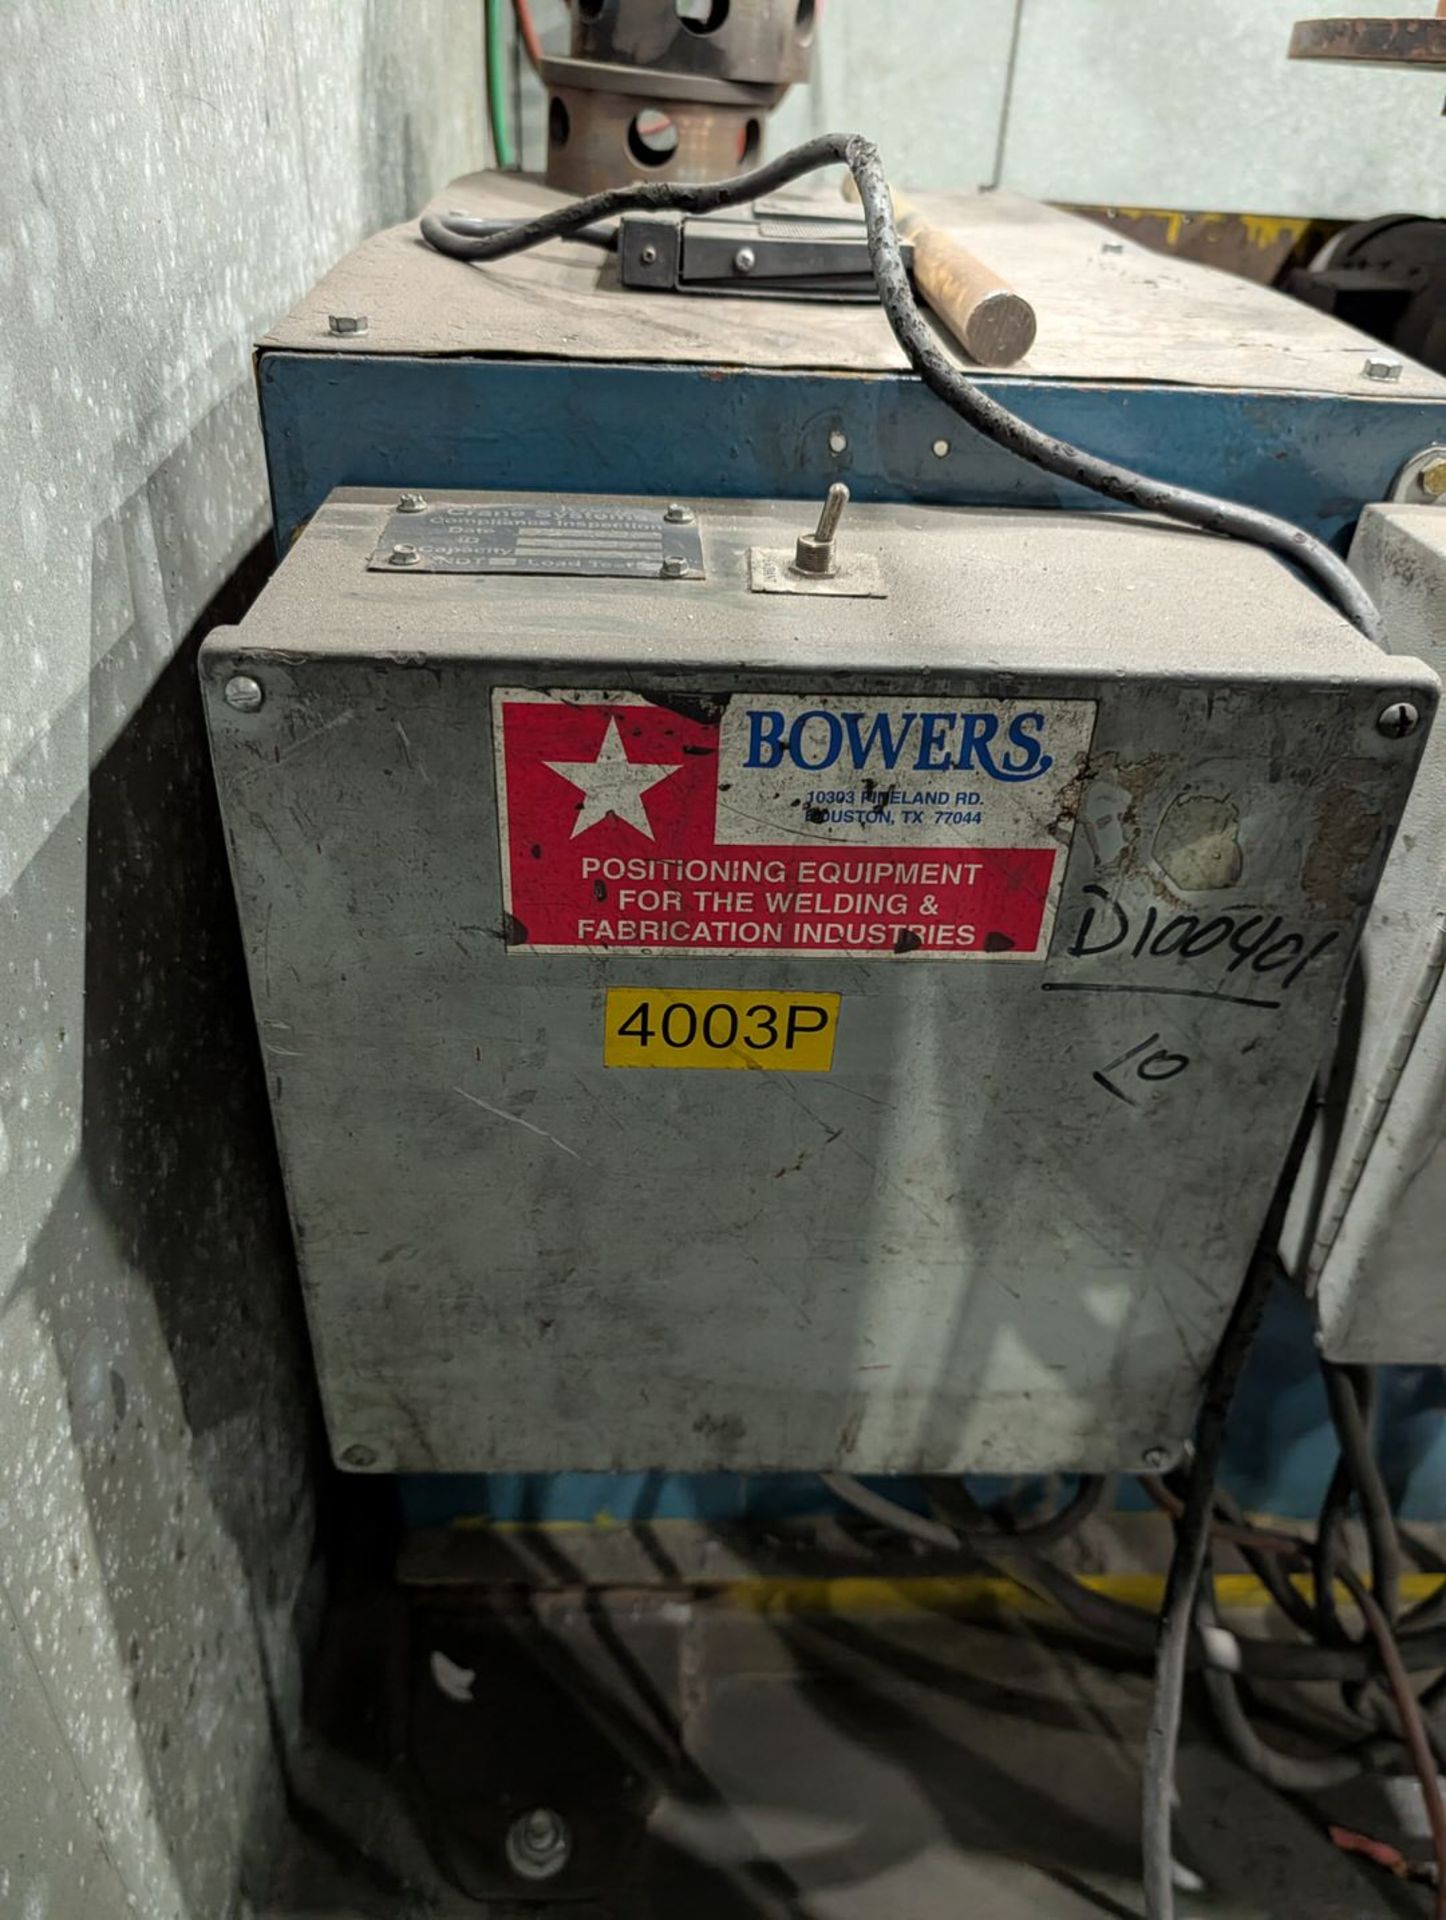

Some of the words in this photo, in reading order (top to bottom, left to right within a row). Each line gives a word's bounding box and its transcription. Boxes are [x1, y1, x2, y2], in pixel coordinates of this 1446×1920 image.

[429, 516, 551, 527] Compliance
[557, 519, 663, 531] Inspection
[448, 526, 496, 535] Date
[418, 545, 513, 556] Capacity
[527, 559, 581, 568] Load
[743, 710, 1053, 782] BOWERS
[806, 790, 855, 805] 10303
[955, 792, 985, 806] RD.
[903, 811, 923, 824] TX
[935, 811, 983, 825] 77044
[581, 857, 786, 884] POSITIONING
[798, 861, 983, 885] EQUIPMENT
[618, 889, 682, 912] FOR
[693, 890, 755, 912] THE
[765, 892, 909, 915] WELDING
[918, 894, 939, 916] &
[577, 919, 783, 944] FABRICATION
[794, 922, 976, 946] INDUSTRIES
[617, 1002, 829, 1050] 4003P
